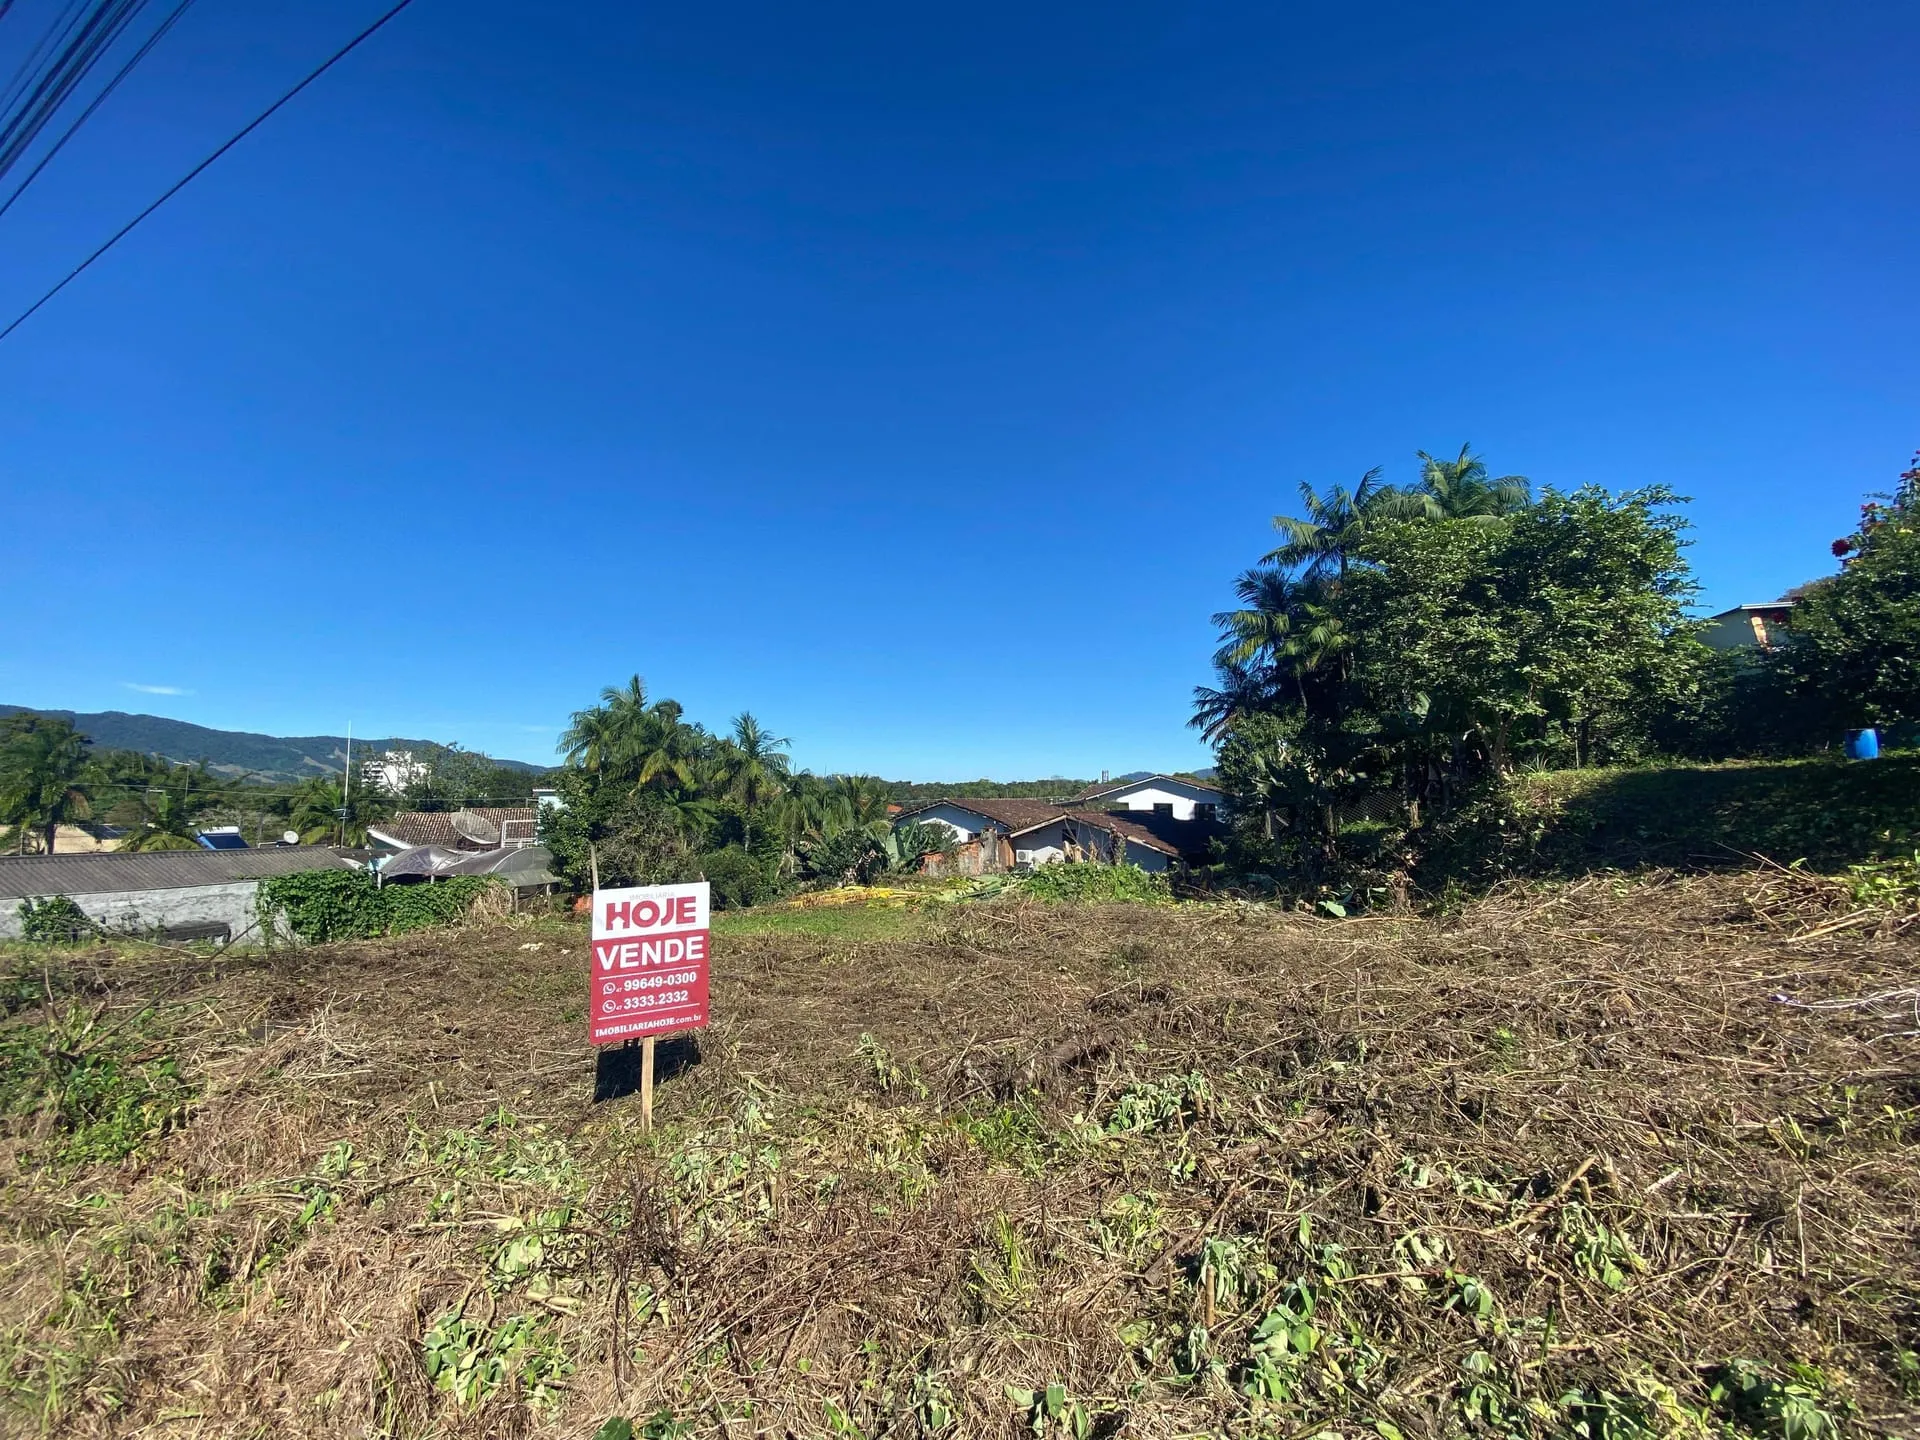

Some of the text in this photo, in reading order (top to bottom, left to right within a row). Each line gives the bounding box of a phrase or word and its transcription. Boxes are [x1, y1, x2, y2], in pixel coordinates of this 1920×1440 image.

[606, 896, 696, 931] HOJE
[597, 936, 704, 971] VENDE
[624, 971, 696, 991] 99649-0300
[624, 990, 688, 1010] 3333.2332
[595, 1014, 702, 1037] IMOBILIARIAHOJE.com.br
